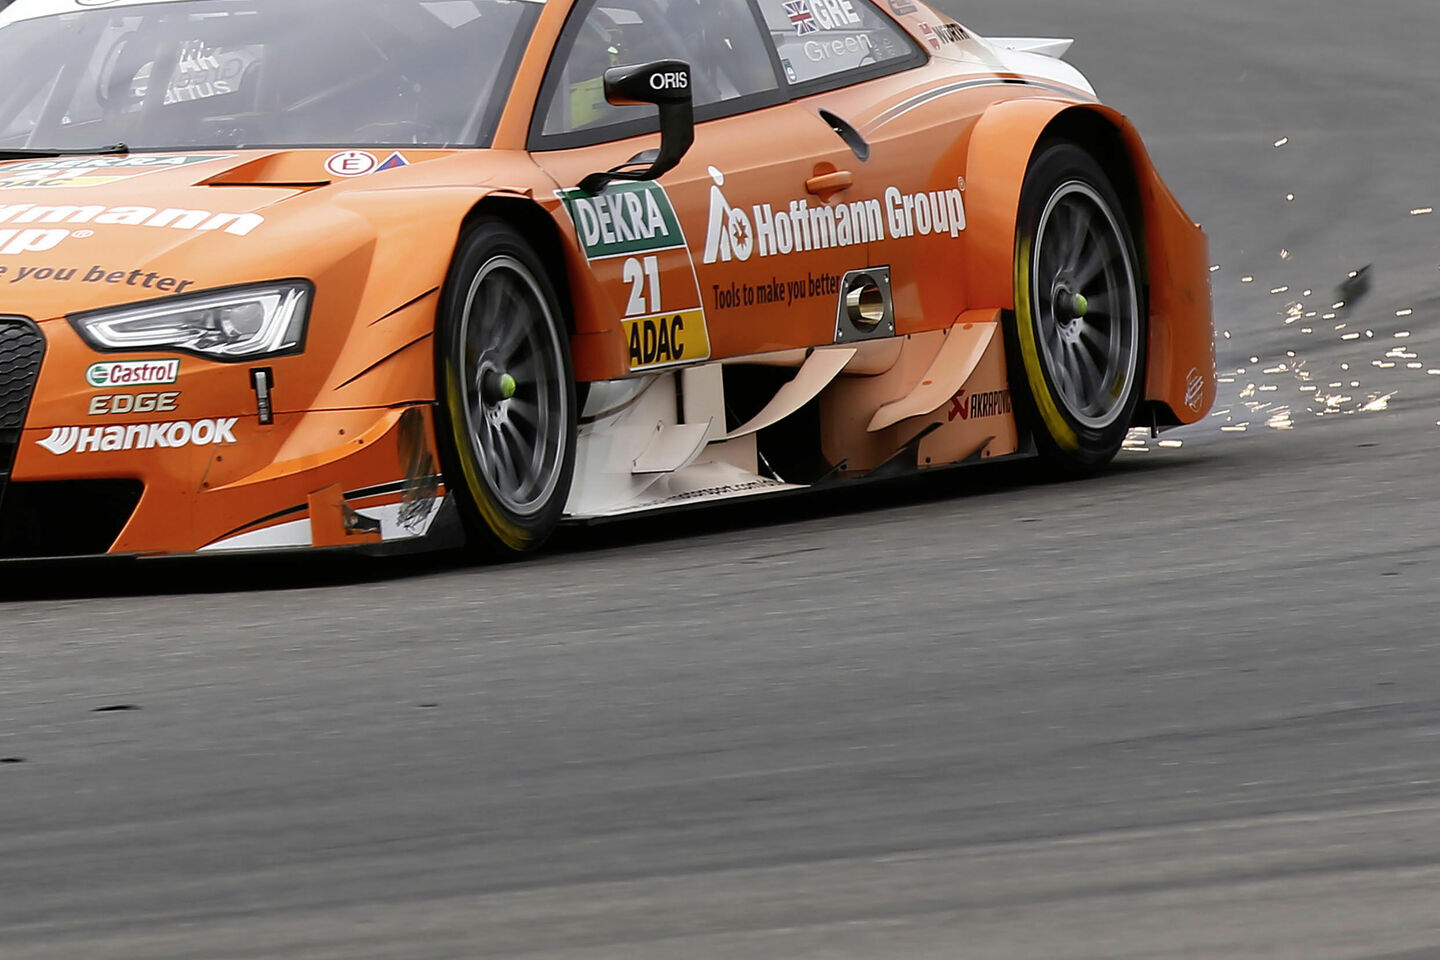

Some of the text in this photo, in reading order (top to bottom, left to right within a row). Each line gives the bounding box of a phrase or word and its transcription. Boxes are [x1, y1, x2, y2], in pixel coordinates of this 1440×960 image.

[804, 33, 873, 63] Green
[649, 72, 688, 90] ORIS
[575, 188, 669, 247] DEKRA
[752, 186, 967, 257] Hoffmann Group
[12, 263, 76, 284] you
[81, 265, 194, 294] better
[623, 256, 662, 316] 21
[713, 274, 841, 310] Tools to make you better
[629, 316, 684, 365] ADAC
[110, 361, 177, 385] Castrol
[89, 392, 181, 415] EDGE
